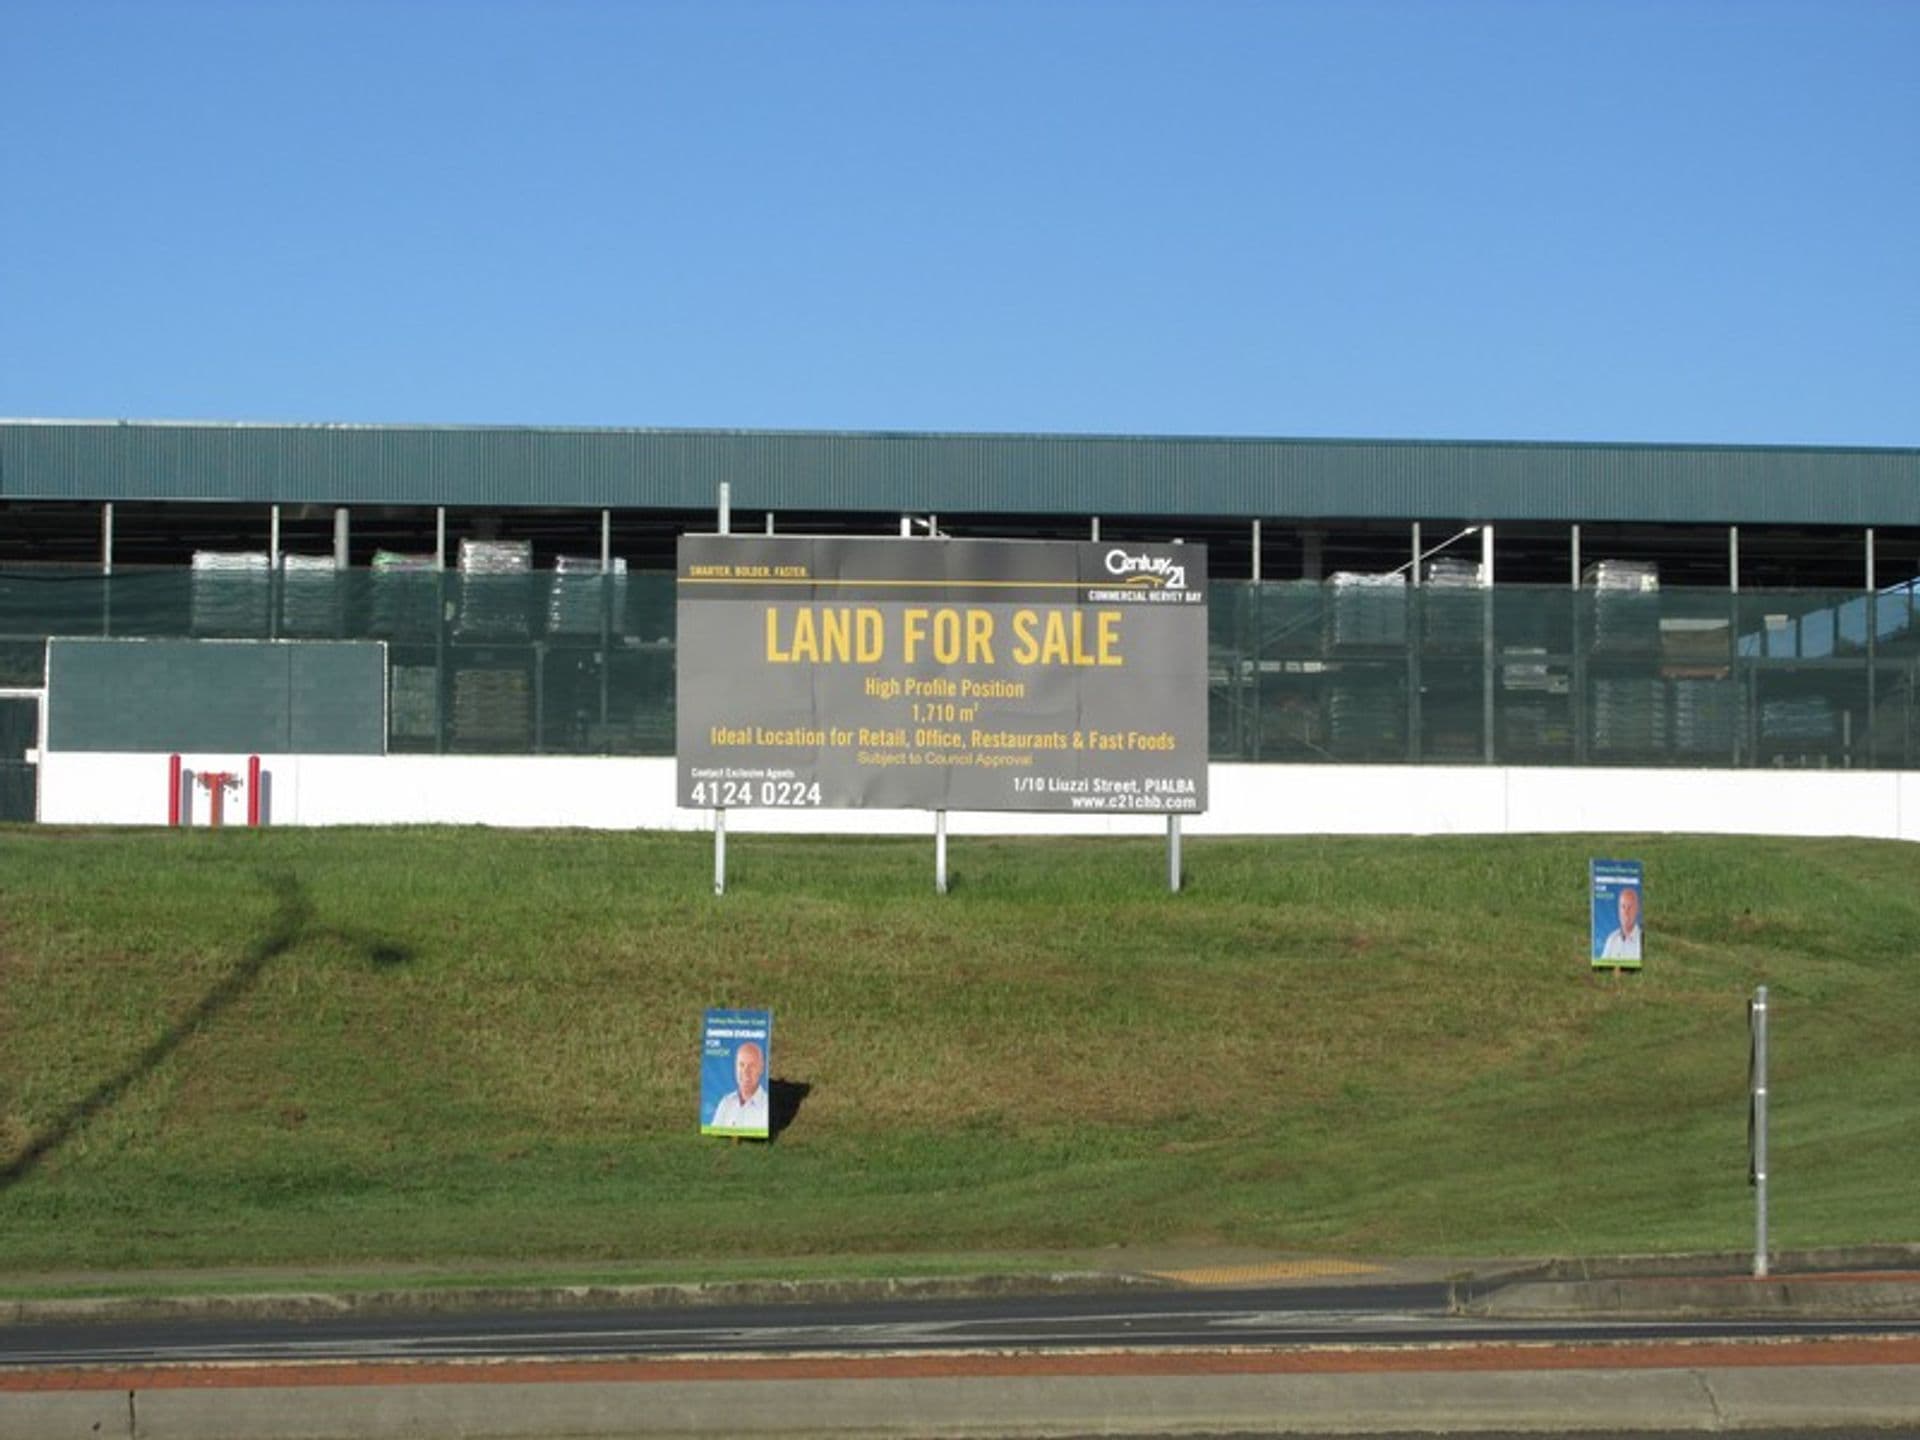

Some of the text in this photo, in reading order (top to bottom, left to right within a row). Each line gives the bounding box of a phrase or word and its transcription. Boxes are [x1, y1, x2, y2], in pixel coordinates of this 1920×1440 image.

[1105, 549, 1187, 588] Century 21
[1088, 590, 1146, 602] COMMERCIAL
[766, 608, 1123, 666] LAND FOR SALE
[865, 678, 1024, 699] High Profile Position
[912, 703, 955, 723] 1,710
[711, 727, 1175, 751] Ideal Location for Retail, Office, Restaurants & Fast Foods
[857, 751, 1033, 768] Subject to Council Approval
[691, 768, 723, 778] Contact
[691, 781, 822, 805] 4124 0224
[1013, 777, 1046, 792] 1/10
[1048, 777, 1089, 792] Liuzzi
[1144, 779, 1196, 793] PIALBA
[1071, 794, 1197, 808] www.c21chb.com
